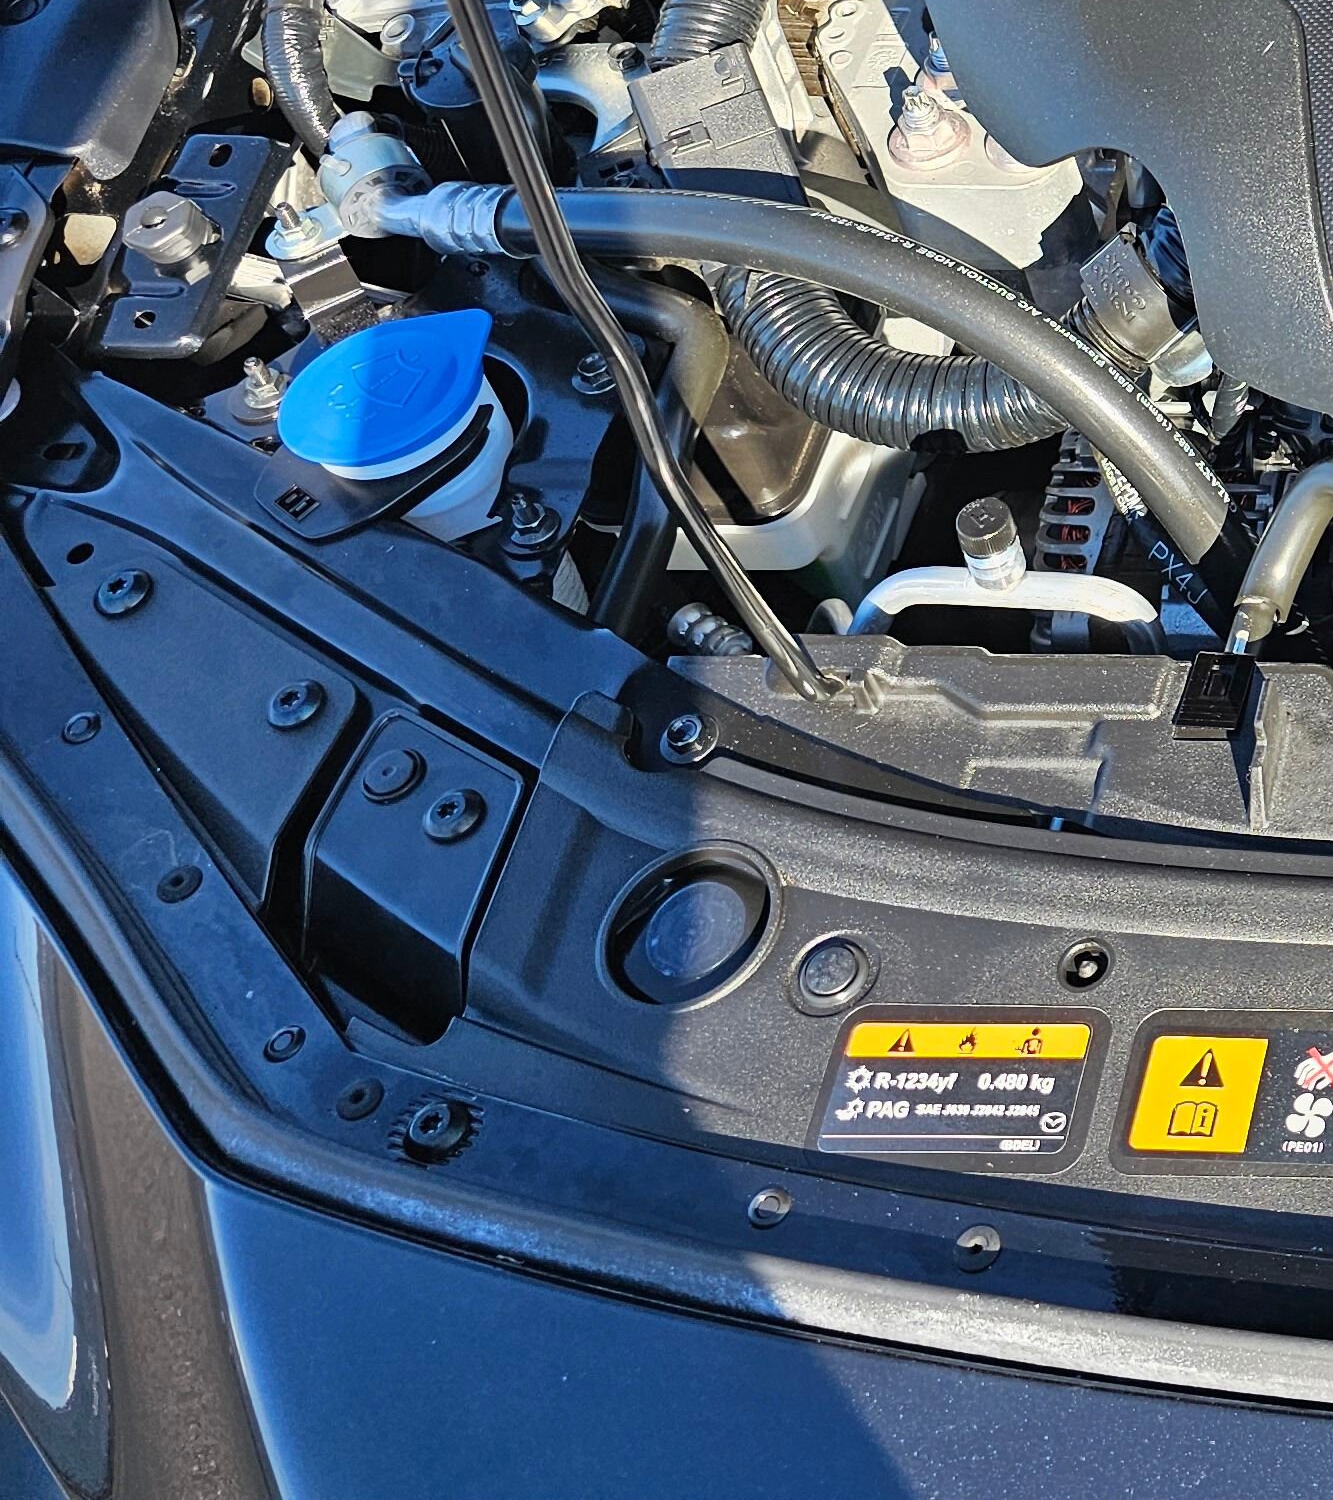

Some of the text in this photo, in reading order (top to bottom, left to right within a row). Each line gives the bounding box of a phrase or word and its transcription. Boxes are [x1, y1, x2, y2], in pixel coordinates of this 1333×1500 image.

[915, 247, 956, 269] HOSE
[956, 265, 1015, 302] SUCTION
[1017, 298, 1043, 318] A/C
[1148, 540, 1208, 605] PX4J
[873, 1072, 1056, 1094] R-1234yf 0.480 kg
[866, 1100, 910, 1119] PAG
[915, 1103, 943, 1116] SAE
[1281, 1140, 1324, 1153] (PE01)
